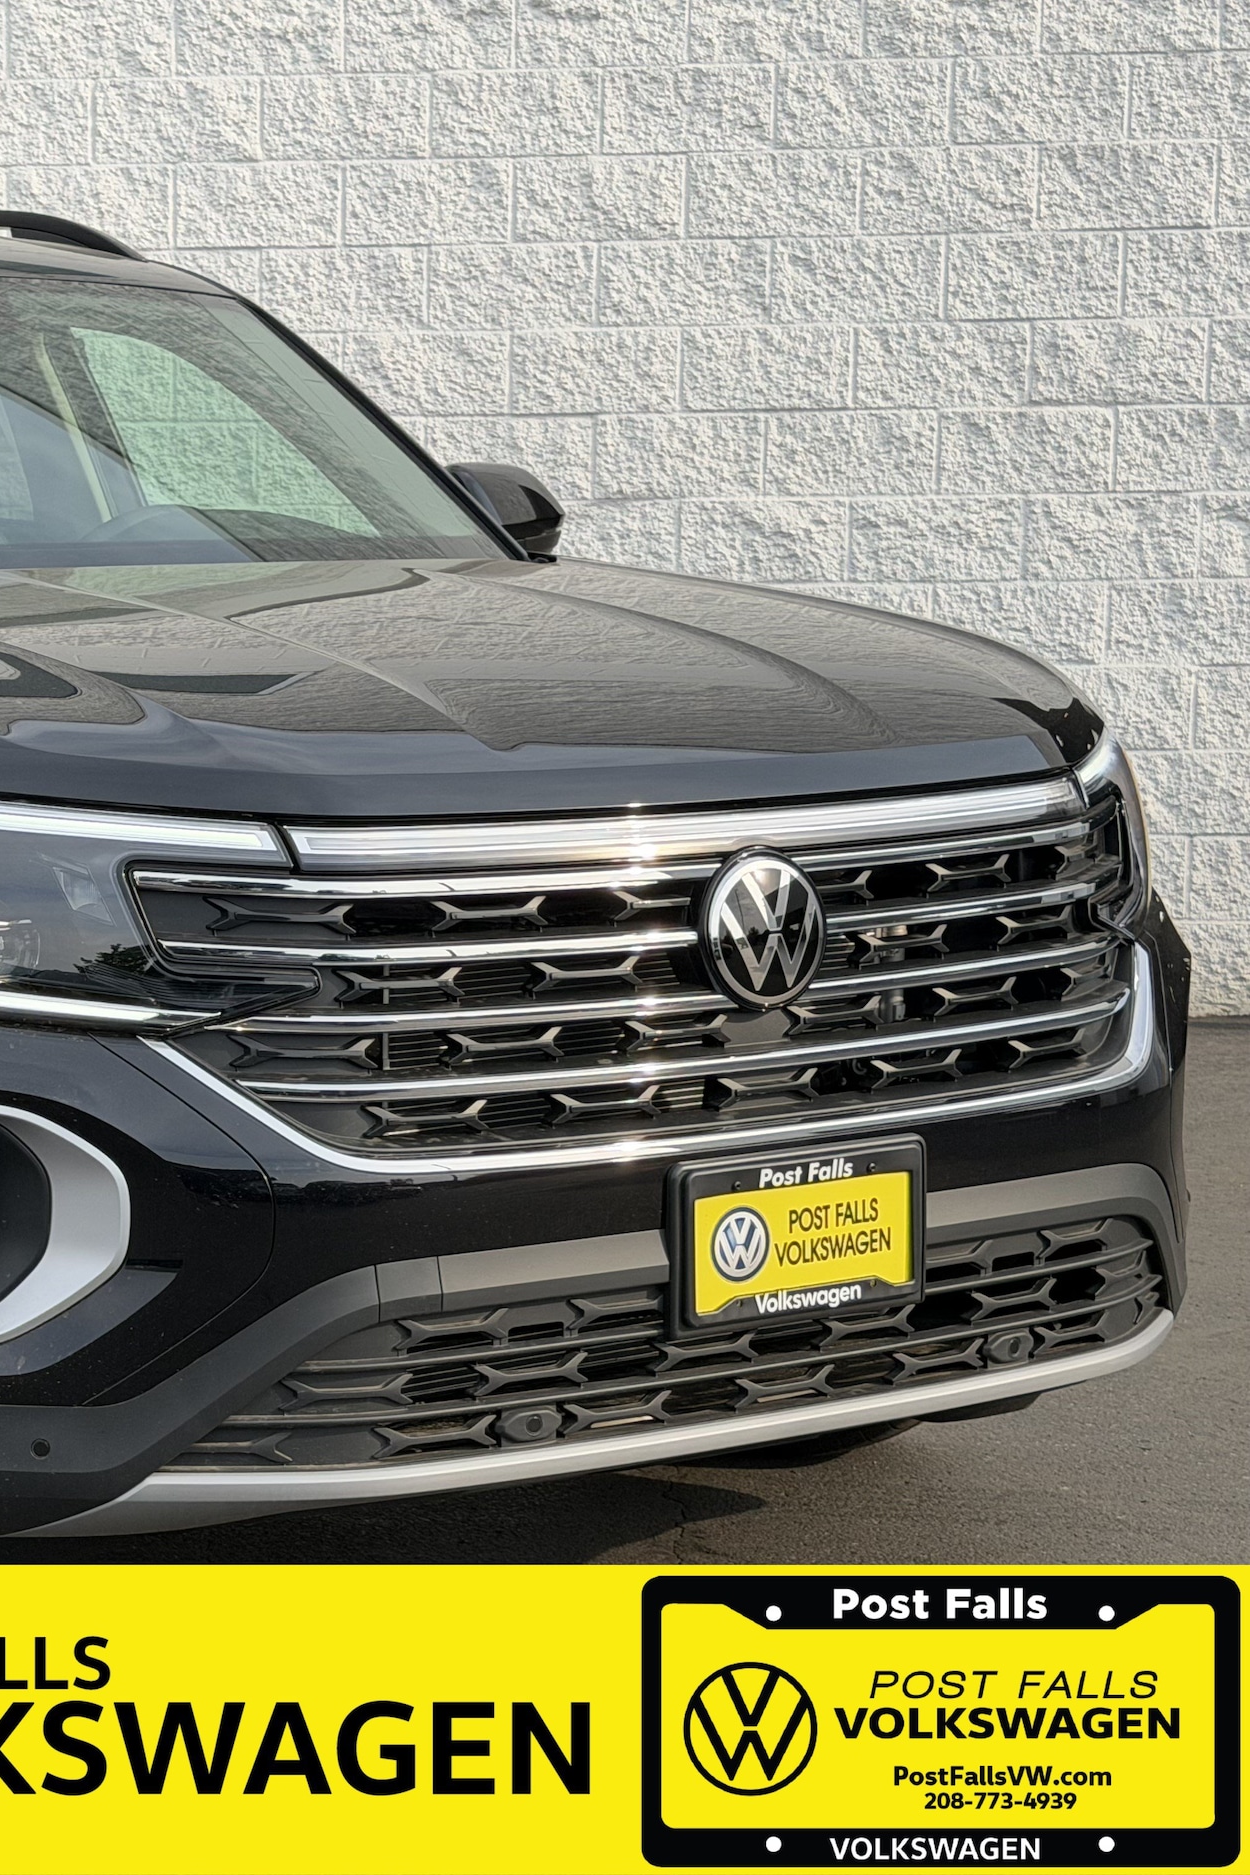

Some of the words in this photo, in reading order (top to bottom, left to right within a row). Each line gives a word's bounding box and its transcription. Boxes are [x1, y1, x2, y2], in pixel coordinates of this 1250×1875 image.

[759, 1166, 803, 1188] Post
[807, 1158, 854, 1180] Falls
[789, 1205, 831, 1233] POST
[835, 1198, 879, 1226] FALLS
[775, 1227, 891, 1267] VOLKSWAGEN
[755, 1284, 862, 1314] Volkswagen
